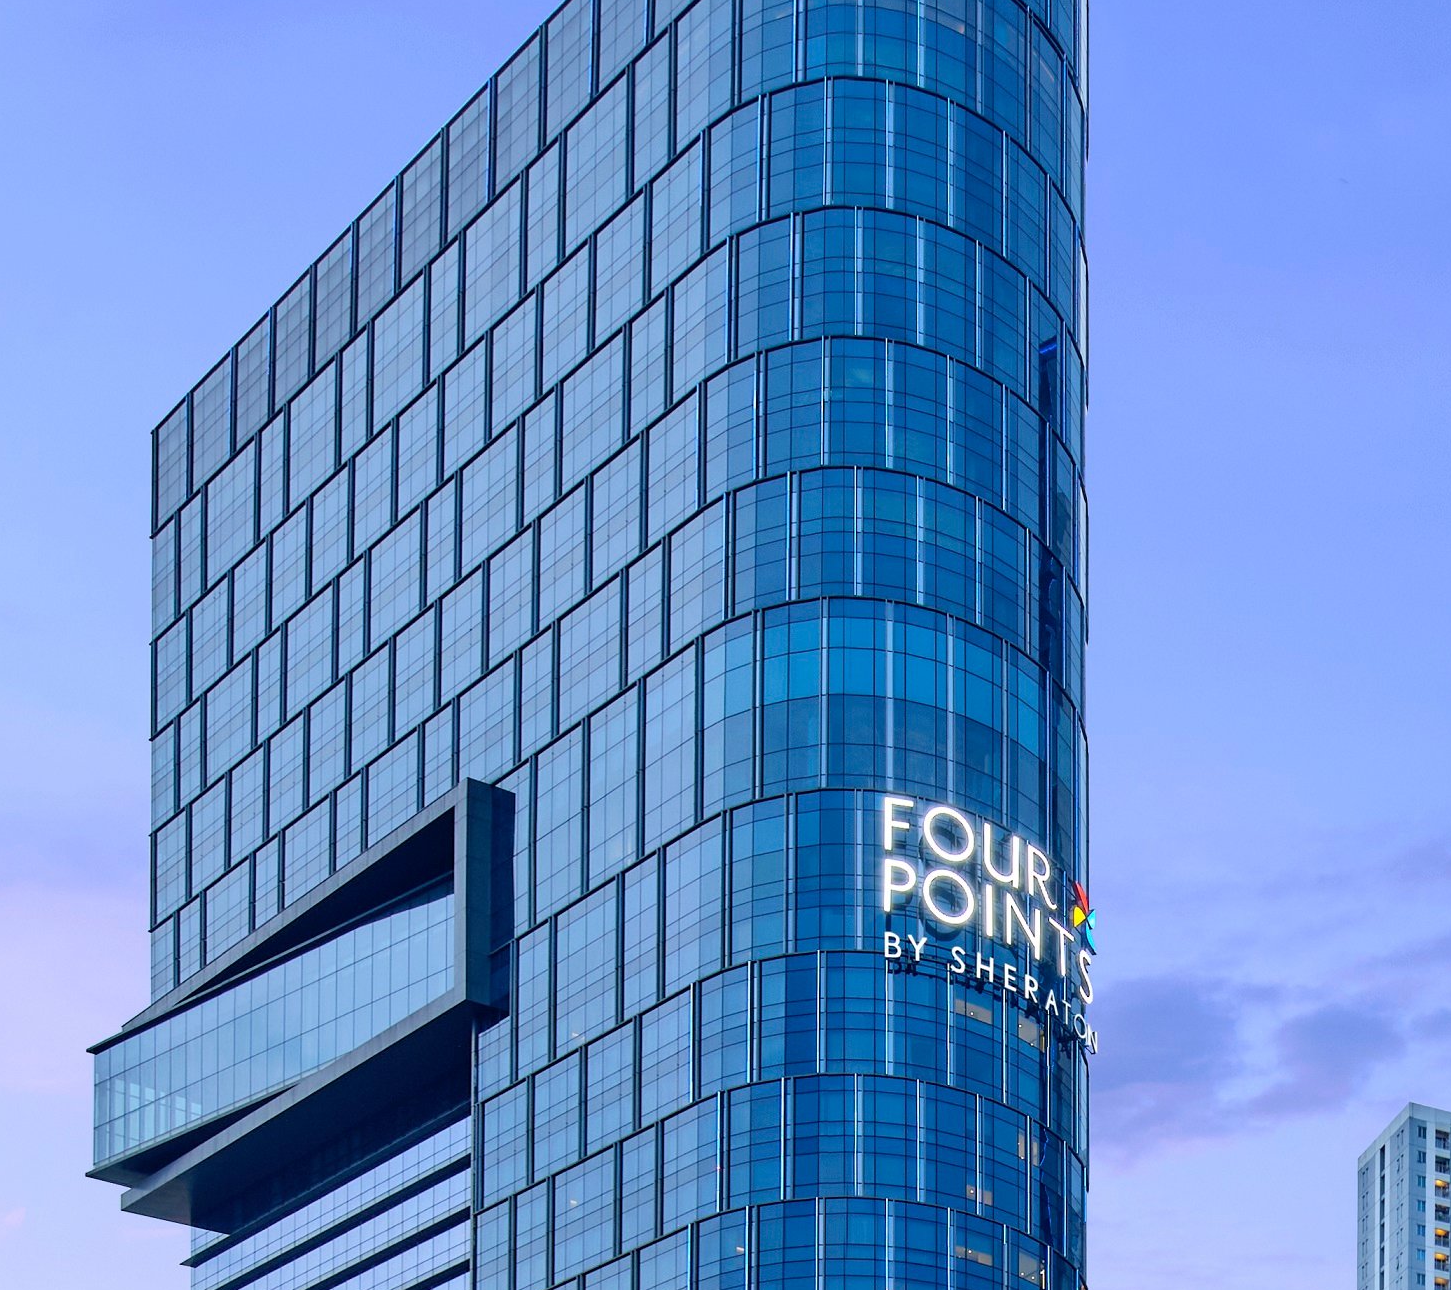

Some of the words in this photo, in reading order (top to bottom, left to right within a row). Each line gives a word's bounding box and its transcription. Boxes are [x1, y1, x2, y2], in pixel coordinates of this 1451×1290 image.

[883, 796, 1057, 910] FOUR
[884, 858, 1094, 1005] POINTS
[884, 931, 928, 962] BY
[950, 946, 1098, 1055] SHERATON
